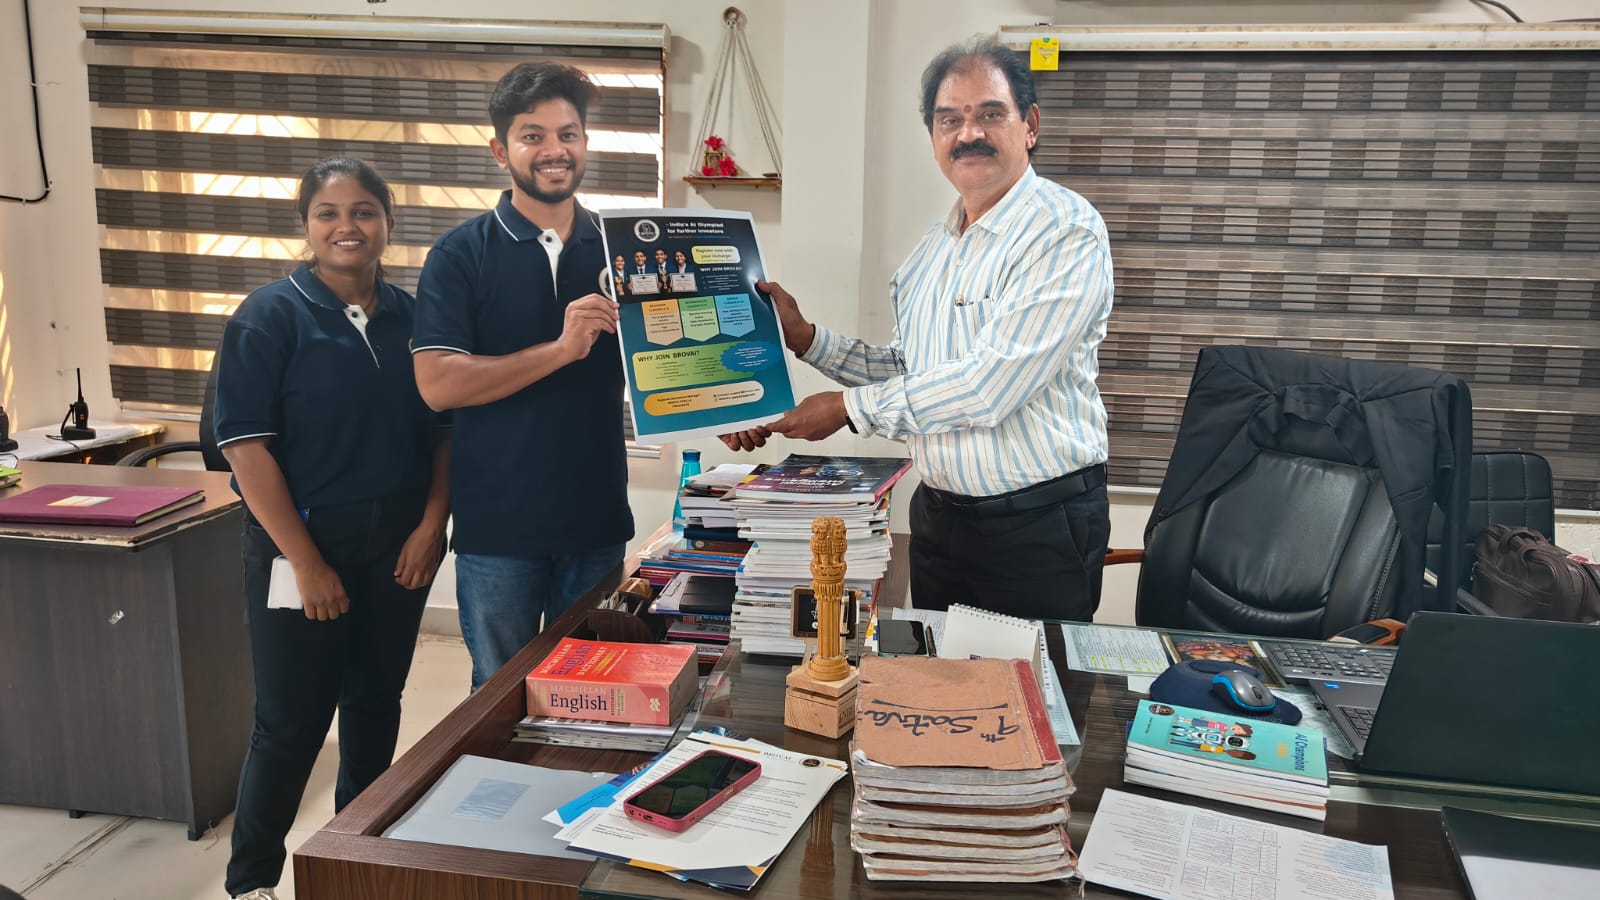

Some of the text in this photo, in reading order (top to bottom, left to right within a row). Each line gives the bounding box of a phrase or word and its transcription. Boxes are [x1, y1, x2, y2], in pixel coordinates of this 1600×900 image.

[637, 355, 653, 363] WHY
[654, 353, 671, 361] JOIN
[539, 643, 573, 674] MACMILLAN
[551, 644, 593, 676] English
[550, 684, 607, 695] MACMILLAN
[550, 693, 608, 713] English
